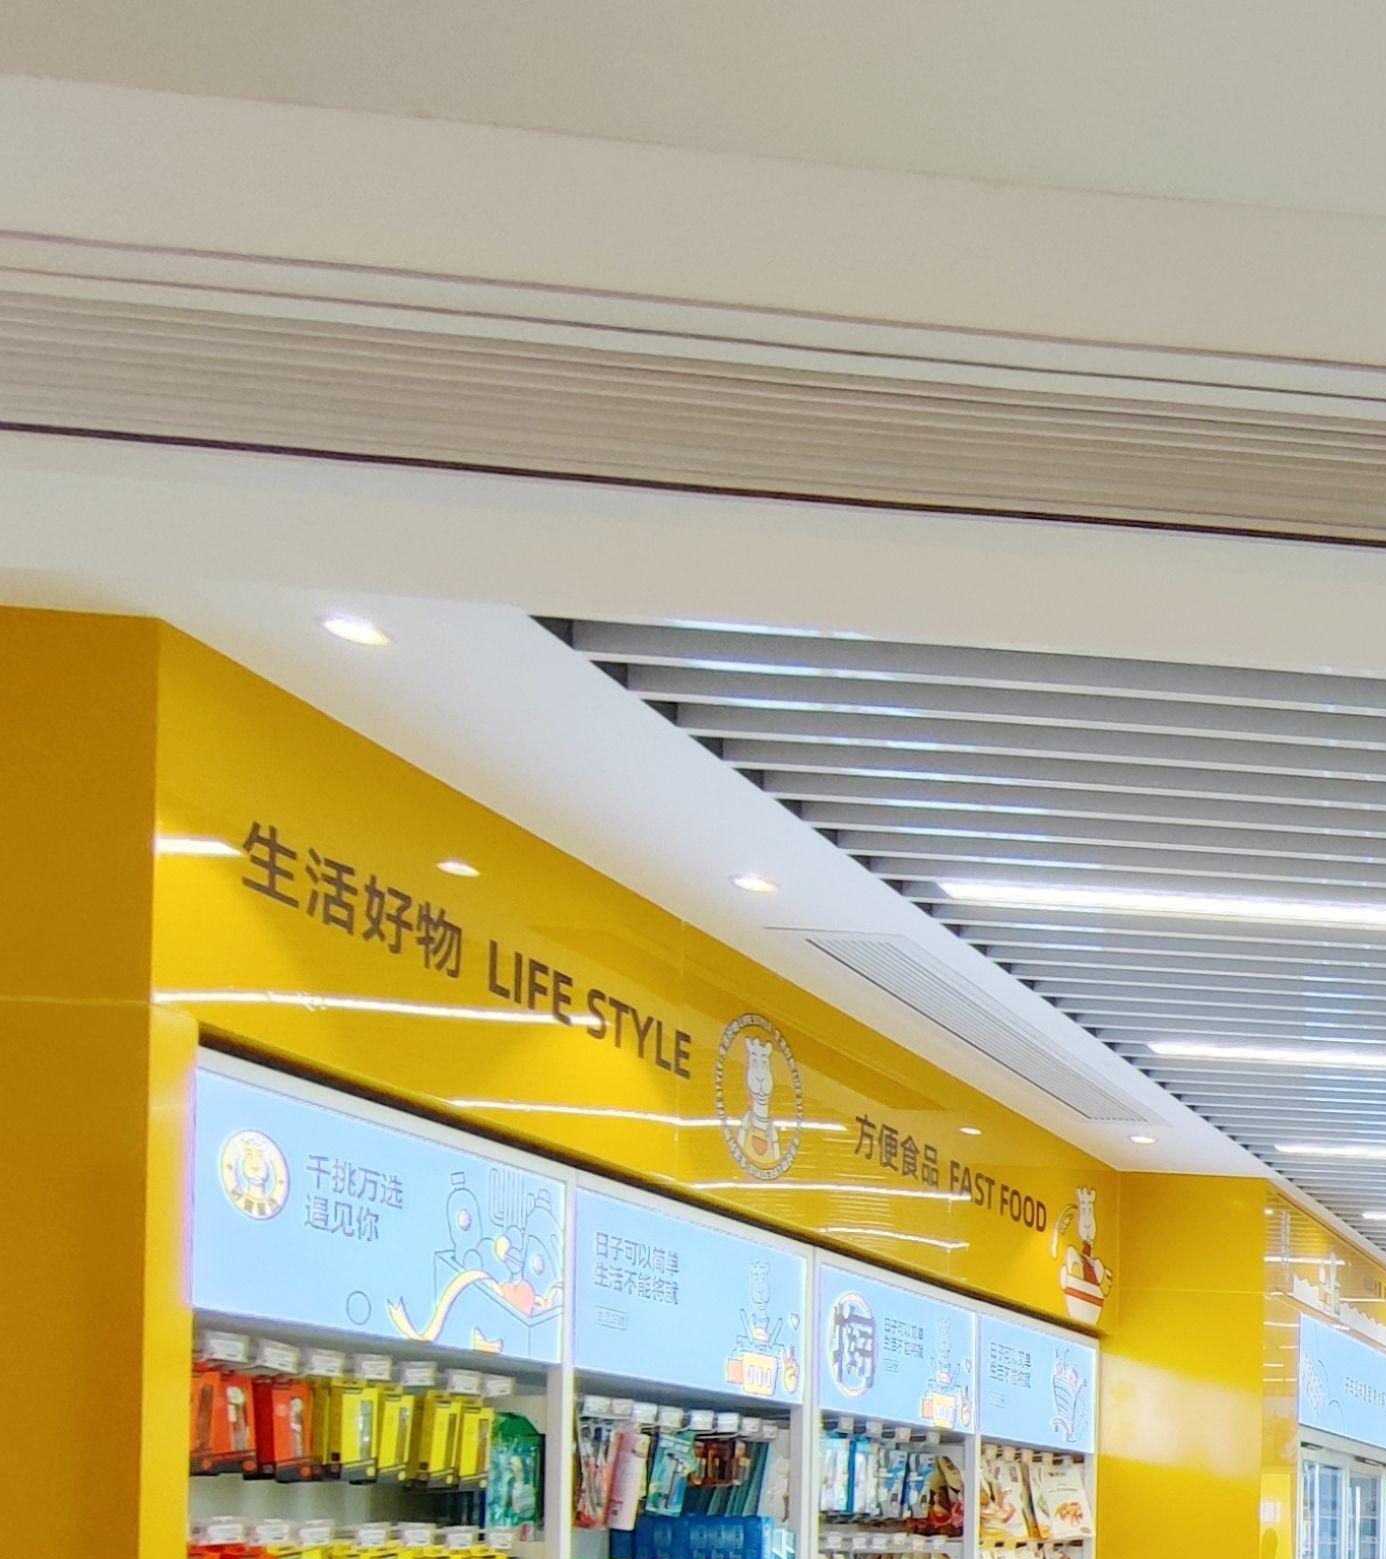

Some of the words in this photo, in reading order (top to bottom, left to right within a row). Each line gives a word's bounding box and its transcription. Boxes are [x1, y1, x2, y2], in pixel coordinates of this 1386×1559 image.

[241, 821, 462, 979] 生活好物
[488, 940, 573, 1026] LIFE
[586, 989, 691, 1079] STYLE
[306, 1153, 404, 1210] 千挑万选
[855, 1114, 939, 1187] 方便食品
[305, 1195, 379, 1242] 遇见你
[950, 1160, 995, 1210] FAST
[1001, 1186, 1047, 1232] FOOD
[596, 1231, 679, 1277] 日子可以简单
